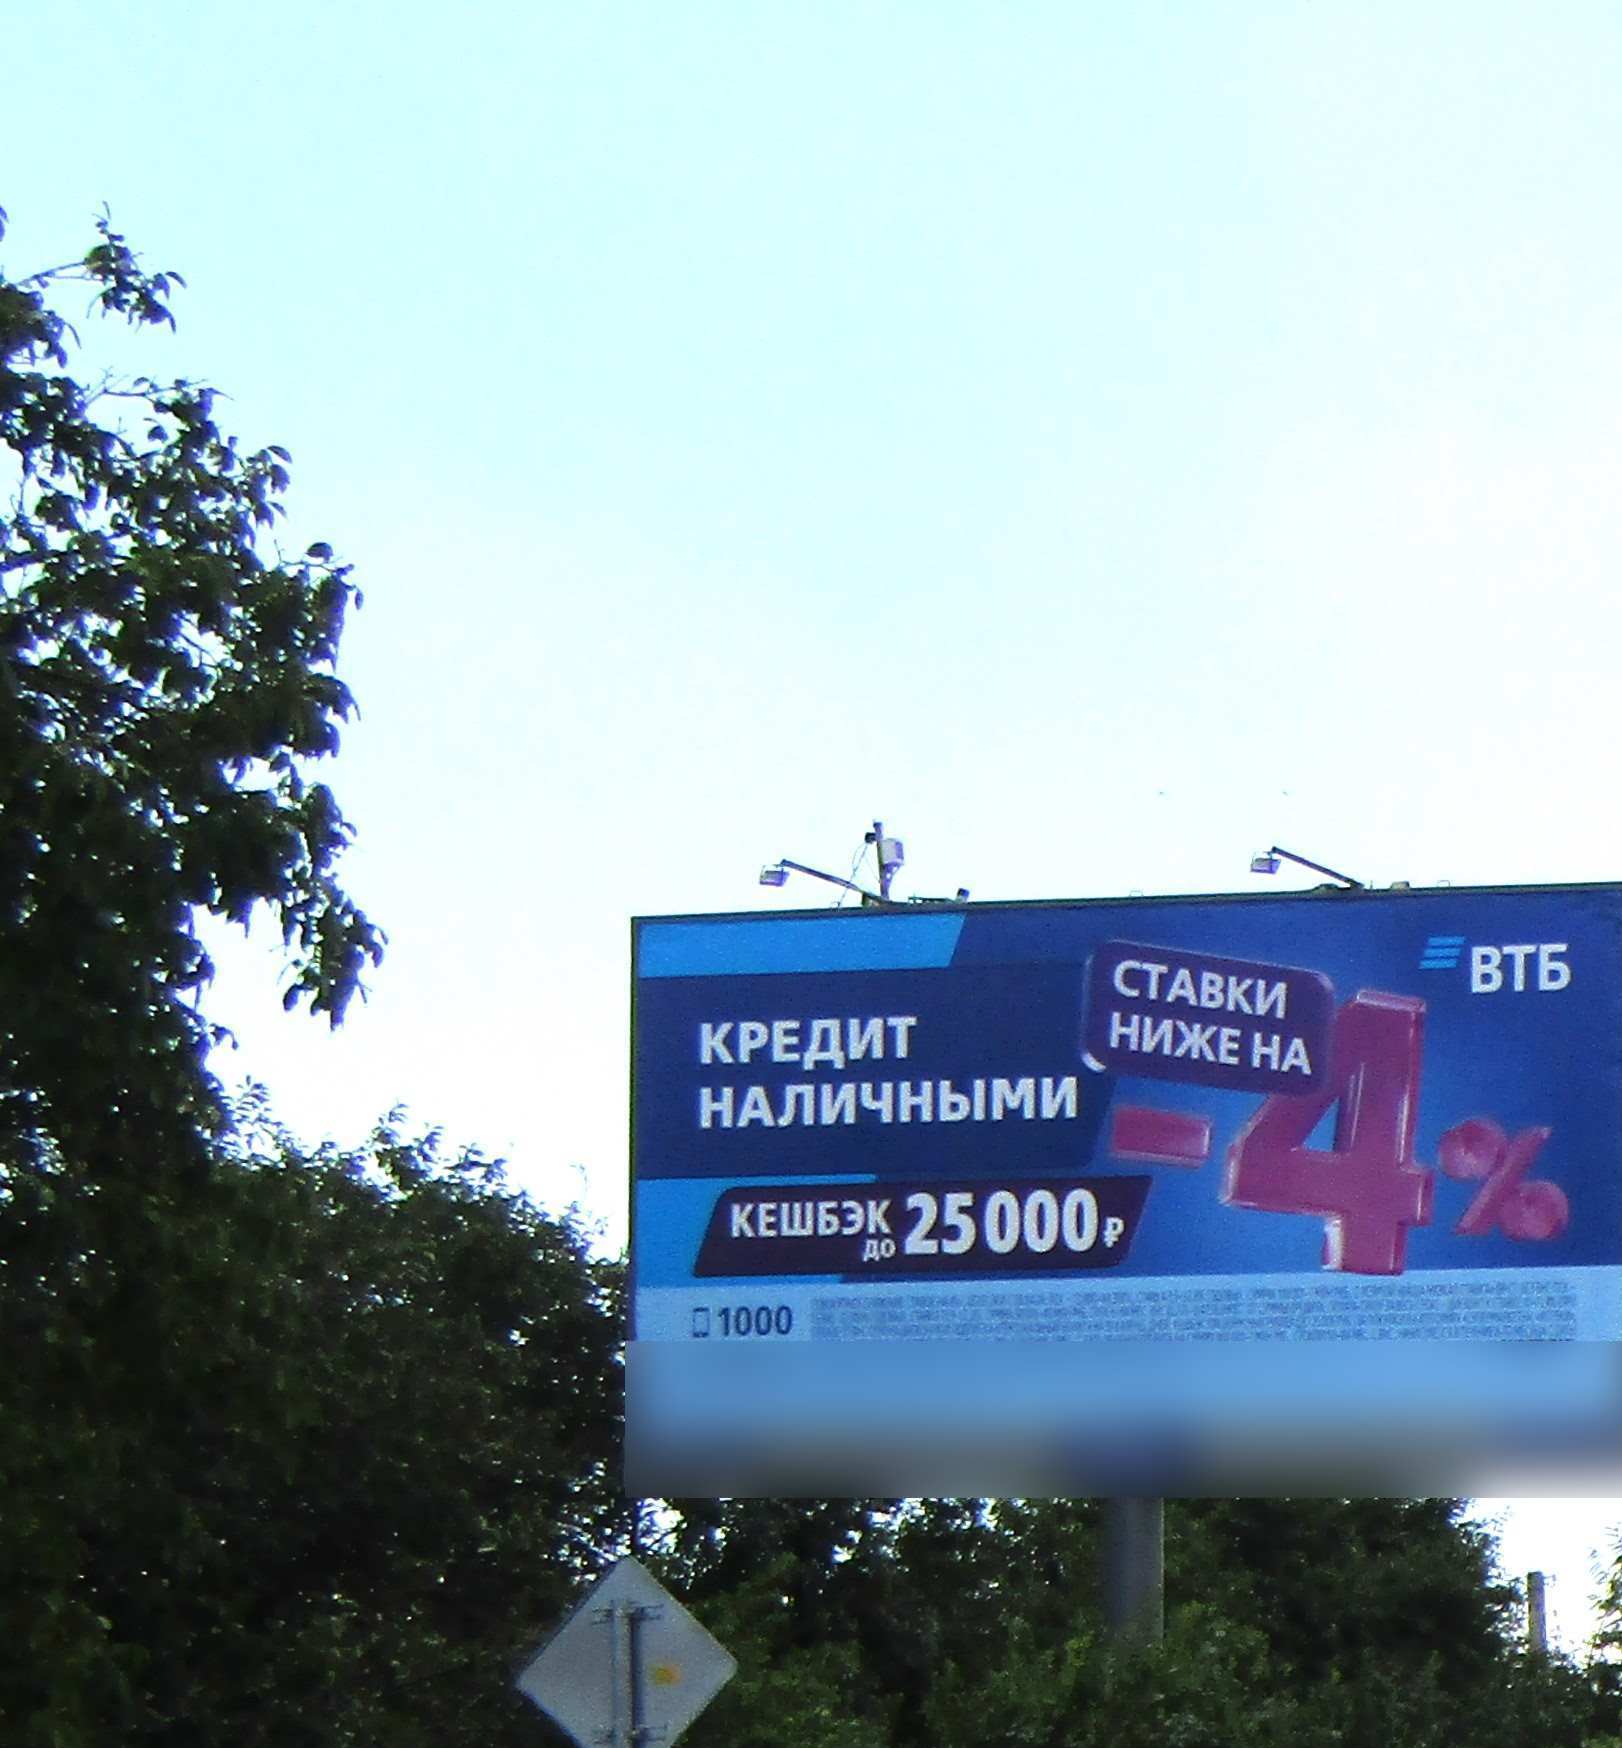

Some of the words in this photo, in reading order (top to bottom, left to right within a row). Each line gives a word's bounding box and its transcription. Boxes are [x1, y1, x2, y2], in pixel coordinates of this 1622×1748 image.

[1113, 959, 1287, 1019] СТАВКИ
[1471, 943, 1571, 993] ВТБ
[700, 1016, 917, 1071] КРЕДИТ
[1109, 1011, 1240, 1065] НИЖЕ
[1252, 1034, 1312, 1075] НА
[700, 1076, 1078, 1129] НАЛИЧНЫМИ
[730, 1200, 892, 1238] КЕШБЭК
[717, 1305, 793, 1336] 1000
